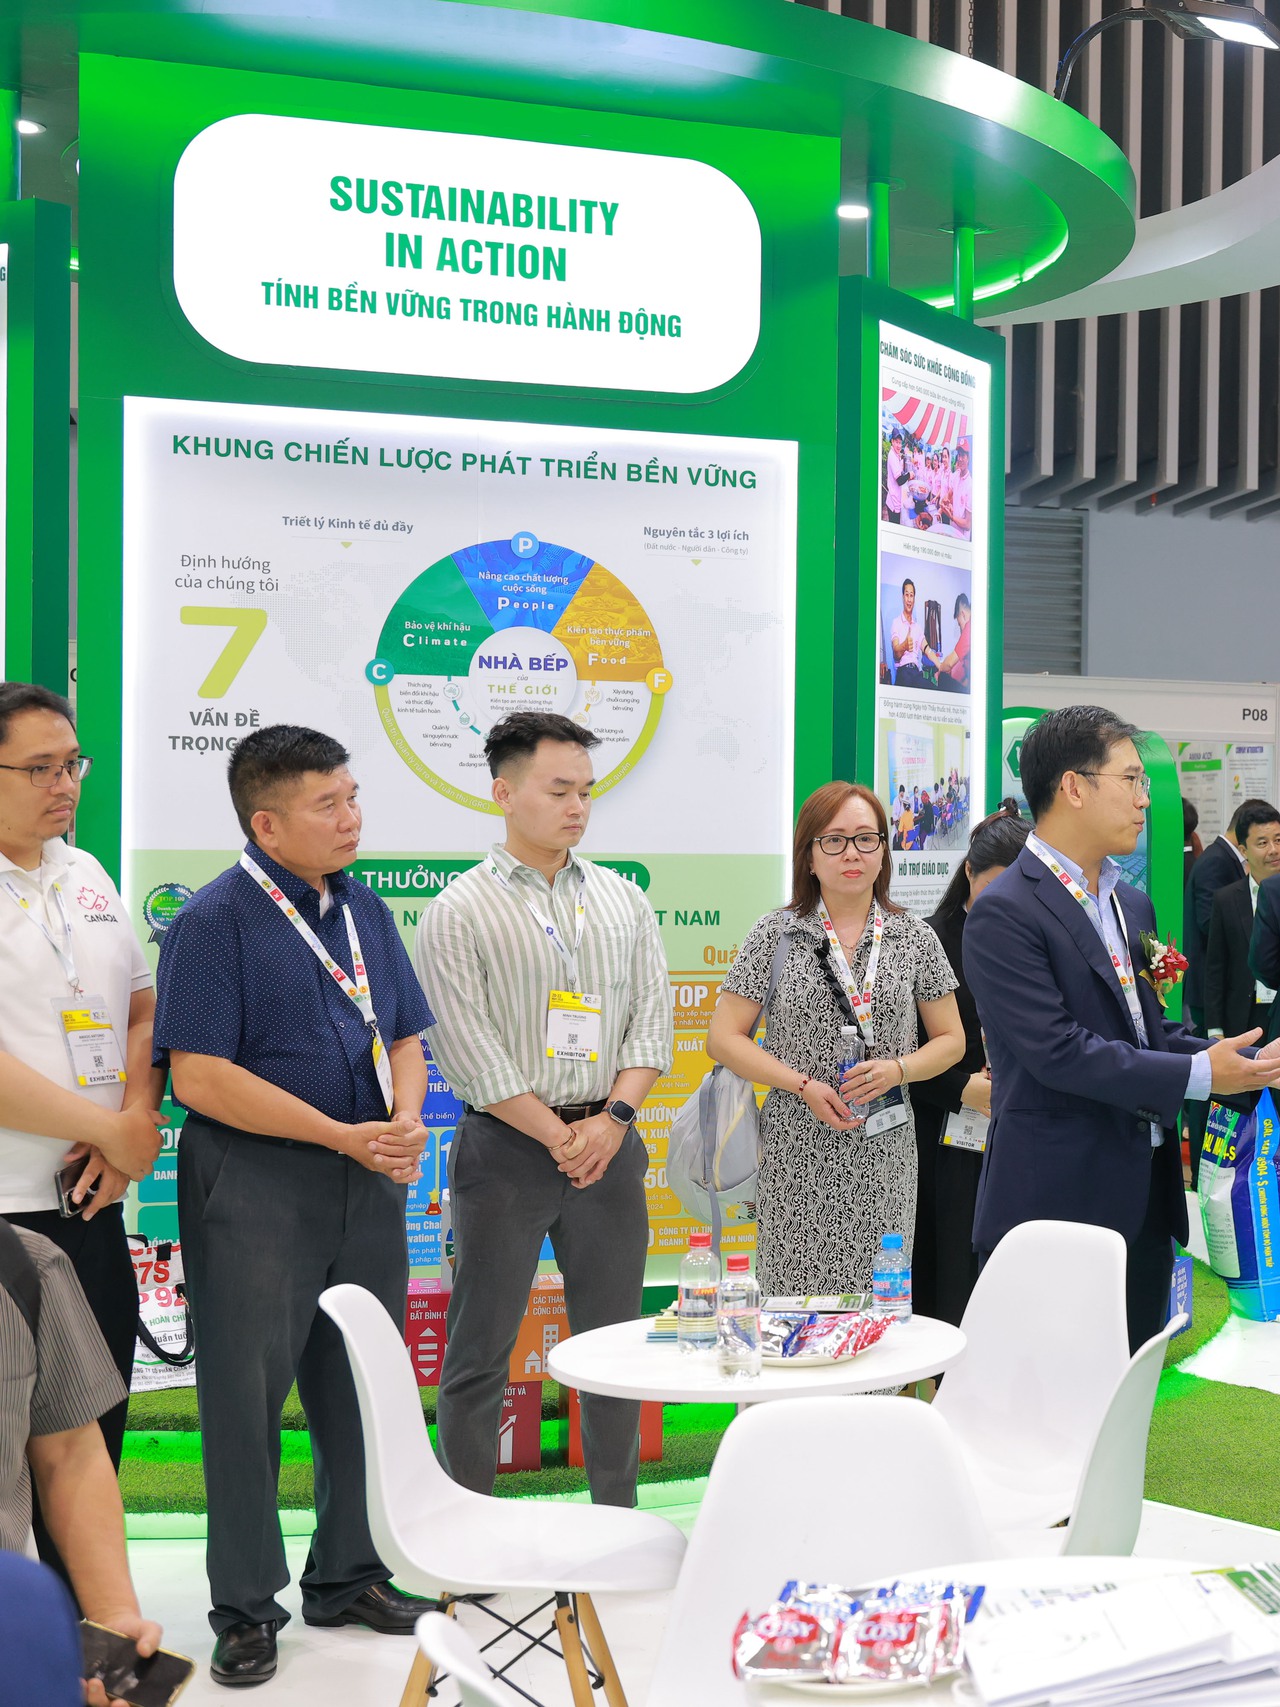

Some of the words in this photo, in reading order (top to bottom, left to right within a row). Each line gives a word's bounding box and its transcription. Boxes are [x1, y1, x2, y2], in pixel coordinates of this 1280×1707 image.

[329, 175, 619, 236] SUSTAINABILITY
[385, 232, 423, 269] IN
[436, 237, 567, 282] ACTION
[261, 277, 318, 309] TÍNH
[327, 281, 377, 313] BỀN
[385, 289, 451, 320] VỮNG
[459, 298, 538, 327] TRONG
[547, 302, 610, 332] HÀNH
[618, 307, 682, 340] ĐỘNG
[900, 348, 912, 364] SÓC
[173, 434, 273, 460] KHUNG
[284, 437, 369, 465] CHIẾN
[379, 447, 452, 473] LƯỢC
[462, 450, 532, 476] PHÁT
[540, 450, 617, 480] TRIỂN
[626, 457, 678, 485] BỀN
[687, 463, 757, 489] VỮNG
[282, 516, 310, 528] Triết
[314, 516, 325, 530] lý
[328, 517, 355, 530] Kinh
[358, 519, 370, 531] tế
[373, 519, 389, 532] đủ
[392, 520, 414, 535] đầy
[643, 526, 686, 542] Nguyên
[688, 526, 705, 539] tắc
[708, 529, 714, 540] 3
[717, 528, 731, 542] lợi
[733, 529, 749, 541] ích
[518, 537, 533, 552] P
[180, 554, 217, 571] Định
[221, 555, 271, 574] hướng
[175, 574, 202, 588] của
[207, 575, 255, 594] chúng
[259, 577, 279, 591] tôi
[479, 571, 502, 583] Nâng
[504, 573, 520, 581] cao
[522, 572, 541, 583] chất
[543, 573, 569, 585] lượng
[502, 583, 520, 594] cuộc
[522, 584, 547, 596] sống
[497, 597, 554, 611] People
[404, 620, 420, 632] Bảo
[422, 622, 435, 632] vệ
[437, 621, 449, 631] khí
[451, 622, 471, 633] hậu
[403, 634, 467, 648] Climate
[180, 606, 267, 699] 7
[588, 653, 626, 666] Food
[478, 653, 523, 671] NHÀ
[529, 653, 568, 672] BẾP
[372, 664, 387, 680] C
[654, 673, 667, 687] F
[488, 683, 517, 694] THẾ
[524, 683, 558, 695] GIỚI
[189, 707, 229, 727] VẤN
[234, 708, 260, 728] ĐỀ
[1242, 708, 1268, 722] P08
[168, 735, 239, 755] TRỌNG
[899, 858, 907, 876] HỖ
[922, 860, 935, 876] GIÁO
[84, 914, 118, 923] CANADA
[674, 911, 720, 926] NAM
[676, 1036, 704, 1052] XUẤT
[557, 1050, 586, 1058] EXHIBITOR
[90, 1074, 116, 1083] EXHIBITOR
[428, 1080, 450, 1093] TIÊU
[436, 1112, 455, 1121] biến)
[956, 1140, 975, 1148] VISITOR
[658, 1226, 678, 1236] CÔNG
[680, 1226, 689, 1235] TY
[690, 1226, 699, 1235] UY
[701, 1225, 712, 1234] TÍN
[658, 1237, 684, 1247] NGÀNH
[738, 1234, 755, 1243] NUÔI
[410, 1300, 428, 1309] GIẢM
[533, 1295, 547, 1304] CÁC
[410, 1310, 423, 1320] BẤT
[425, 1311, 442, 1320] BÌNH
[533, 1305, 551, 1316] CỘNG
[149, 1314, 170, 1326] HOÀN
[517, 1385, 527, 1395] VÀ
